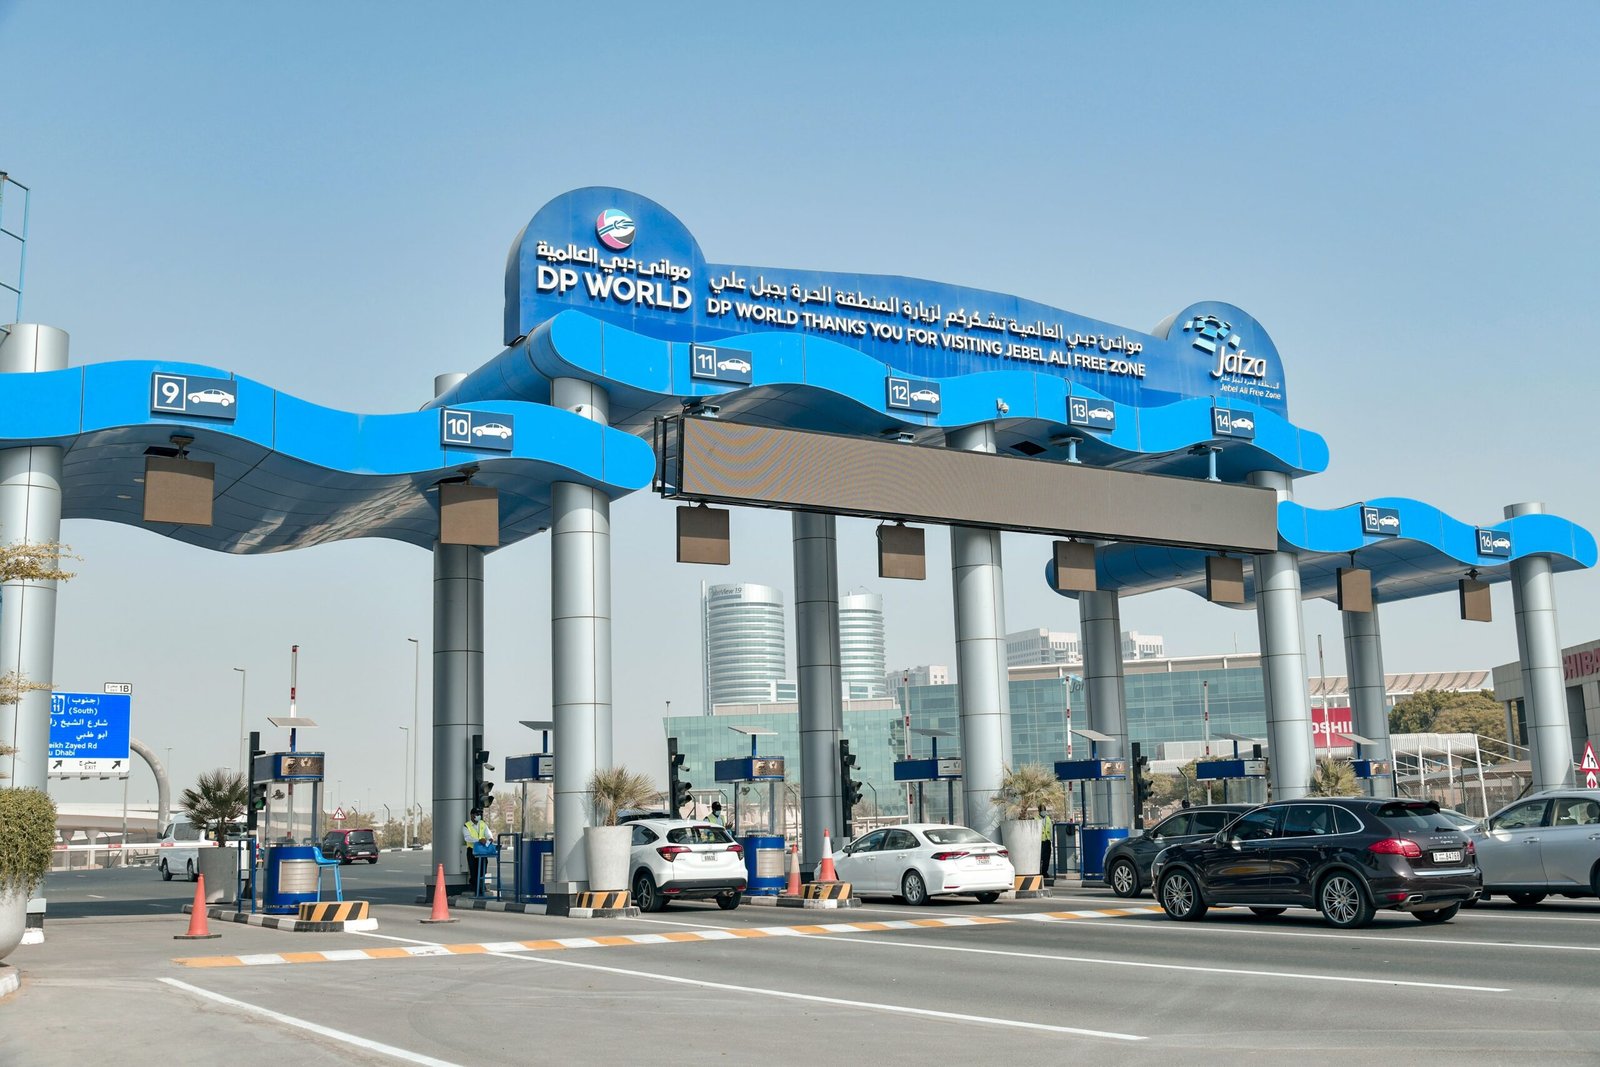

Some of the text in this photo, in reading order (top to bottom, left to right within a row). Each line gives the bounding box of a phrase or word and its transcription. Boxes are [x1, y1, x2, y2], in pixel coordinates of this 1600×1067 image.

[536, 240, 599, 262] العالمية
[600, 256, 637, 273] دبي
[537, 264, 693, 310] DP WORLD
[709, 271, 1144, 355] موانئ دبي العالمية تشكركم لزيارة المنطقة الحرة بجبل علي
[707, 297, 1147, 377] DP WORLD THANKS YOU FOR VISITING JEBEL ALI FREE ZONE
[698, 353, 713, 370] 11
[161, 381, 180, 404] 9
[892, 385, 908, 401] 12
[1220, 383, 1281, 399] Jebel Ali Free Zone
[1072, 403, 1086, 418] 13
[447, 417, 468, 436] 10
[1216, 414, 1229, 428] 14
[1366, 513, 1378, 526] 15
[1481, 535, 1492, 548] 16
[119, 685, 130, 693] 1B
[68, 707, 98, 716] (South)
[60, 718, 84, 728] الشيخ
[87, 719, 108, 728] شارع
[76, 731, 94, 741] ظبي
[65, 742, 86, 751] Zayed
